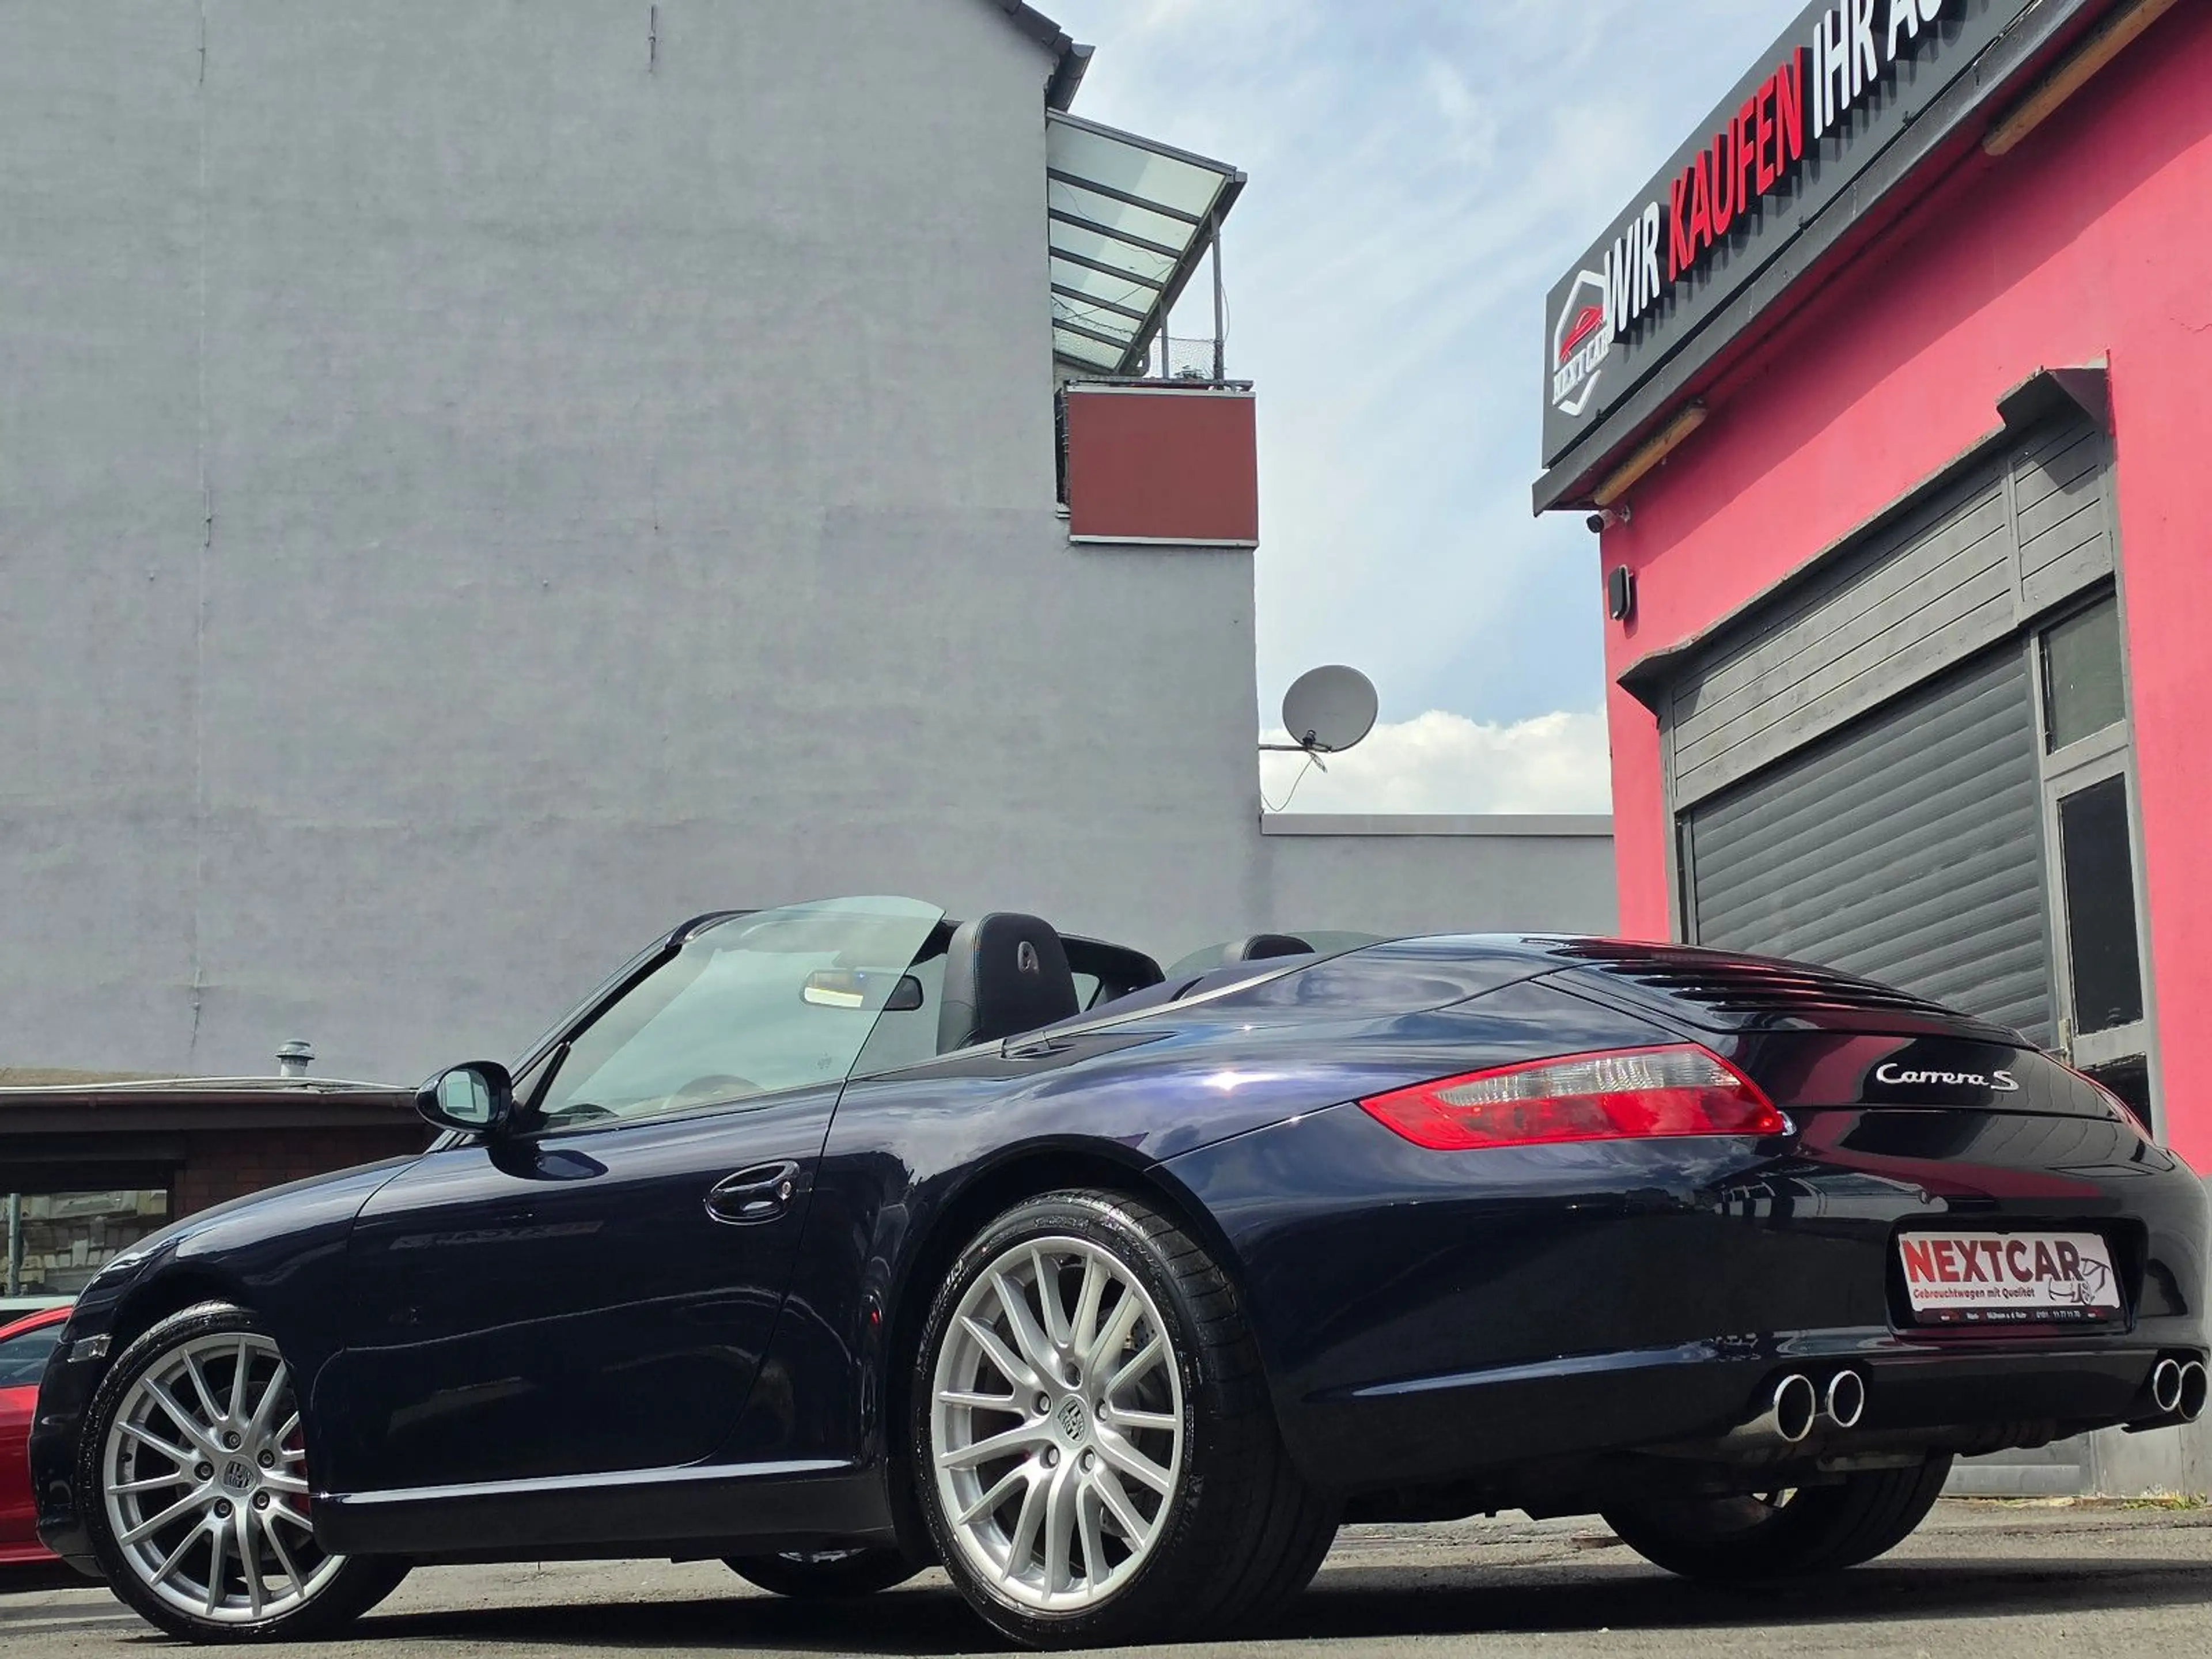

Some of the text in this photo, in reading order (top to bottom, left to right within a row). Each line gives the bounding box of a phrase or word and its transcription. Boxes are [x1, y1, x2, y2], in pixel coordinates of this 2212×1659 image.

[1603, 202, 1660, 343] WIR
[1669, 44, 1802, 282] KAUFEN
[1813, 0, 1877, 139] IHR
[1876, 1063, 2019, 1090] Carrera S
[1902, 1240, 2085, 1283] NEXTCAR
[1913, 1286, 2035, 1300] Gebrauchtwagen mit Qualität
